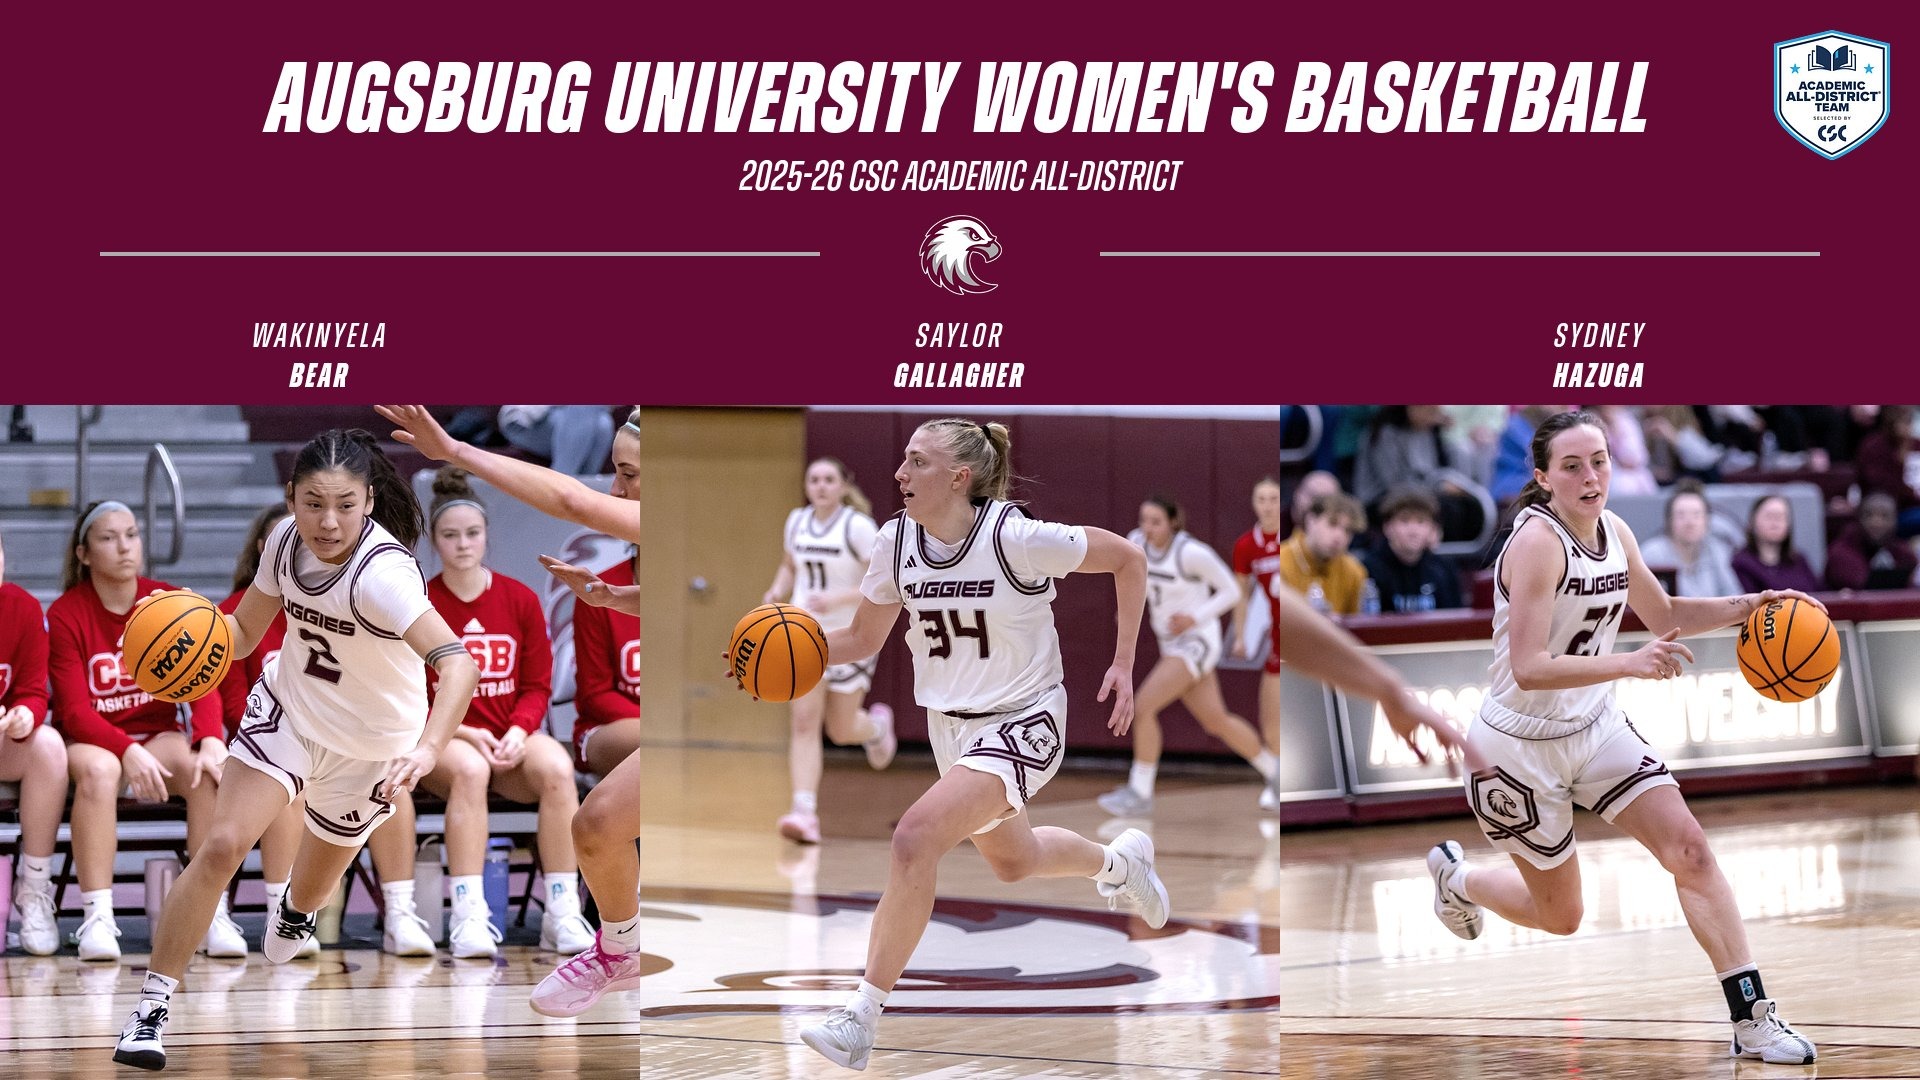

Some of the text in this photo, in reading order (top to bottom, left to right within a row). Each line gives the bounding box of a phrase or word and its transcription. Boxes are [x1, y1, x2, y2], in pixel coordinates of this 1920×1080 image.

[281, 594, 356, 637] UGGIES
[917, 608, 991, 661] 34
[150, 630, 196, 681] NCAA
[167, 642, 226, 699] Wilson
[298, 626, 342, 686] 2
[460, 634, 518, 679] SB
